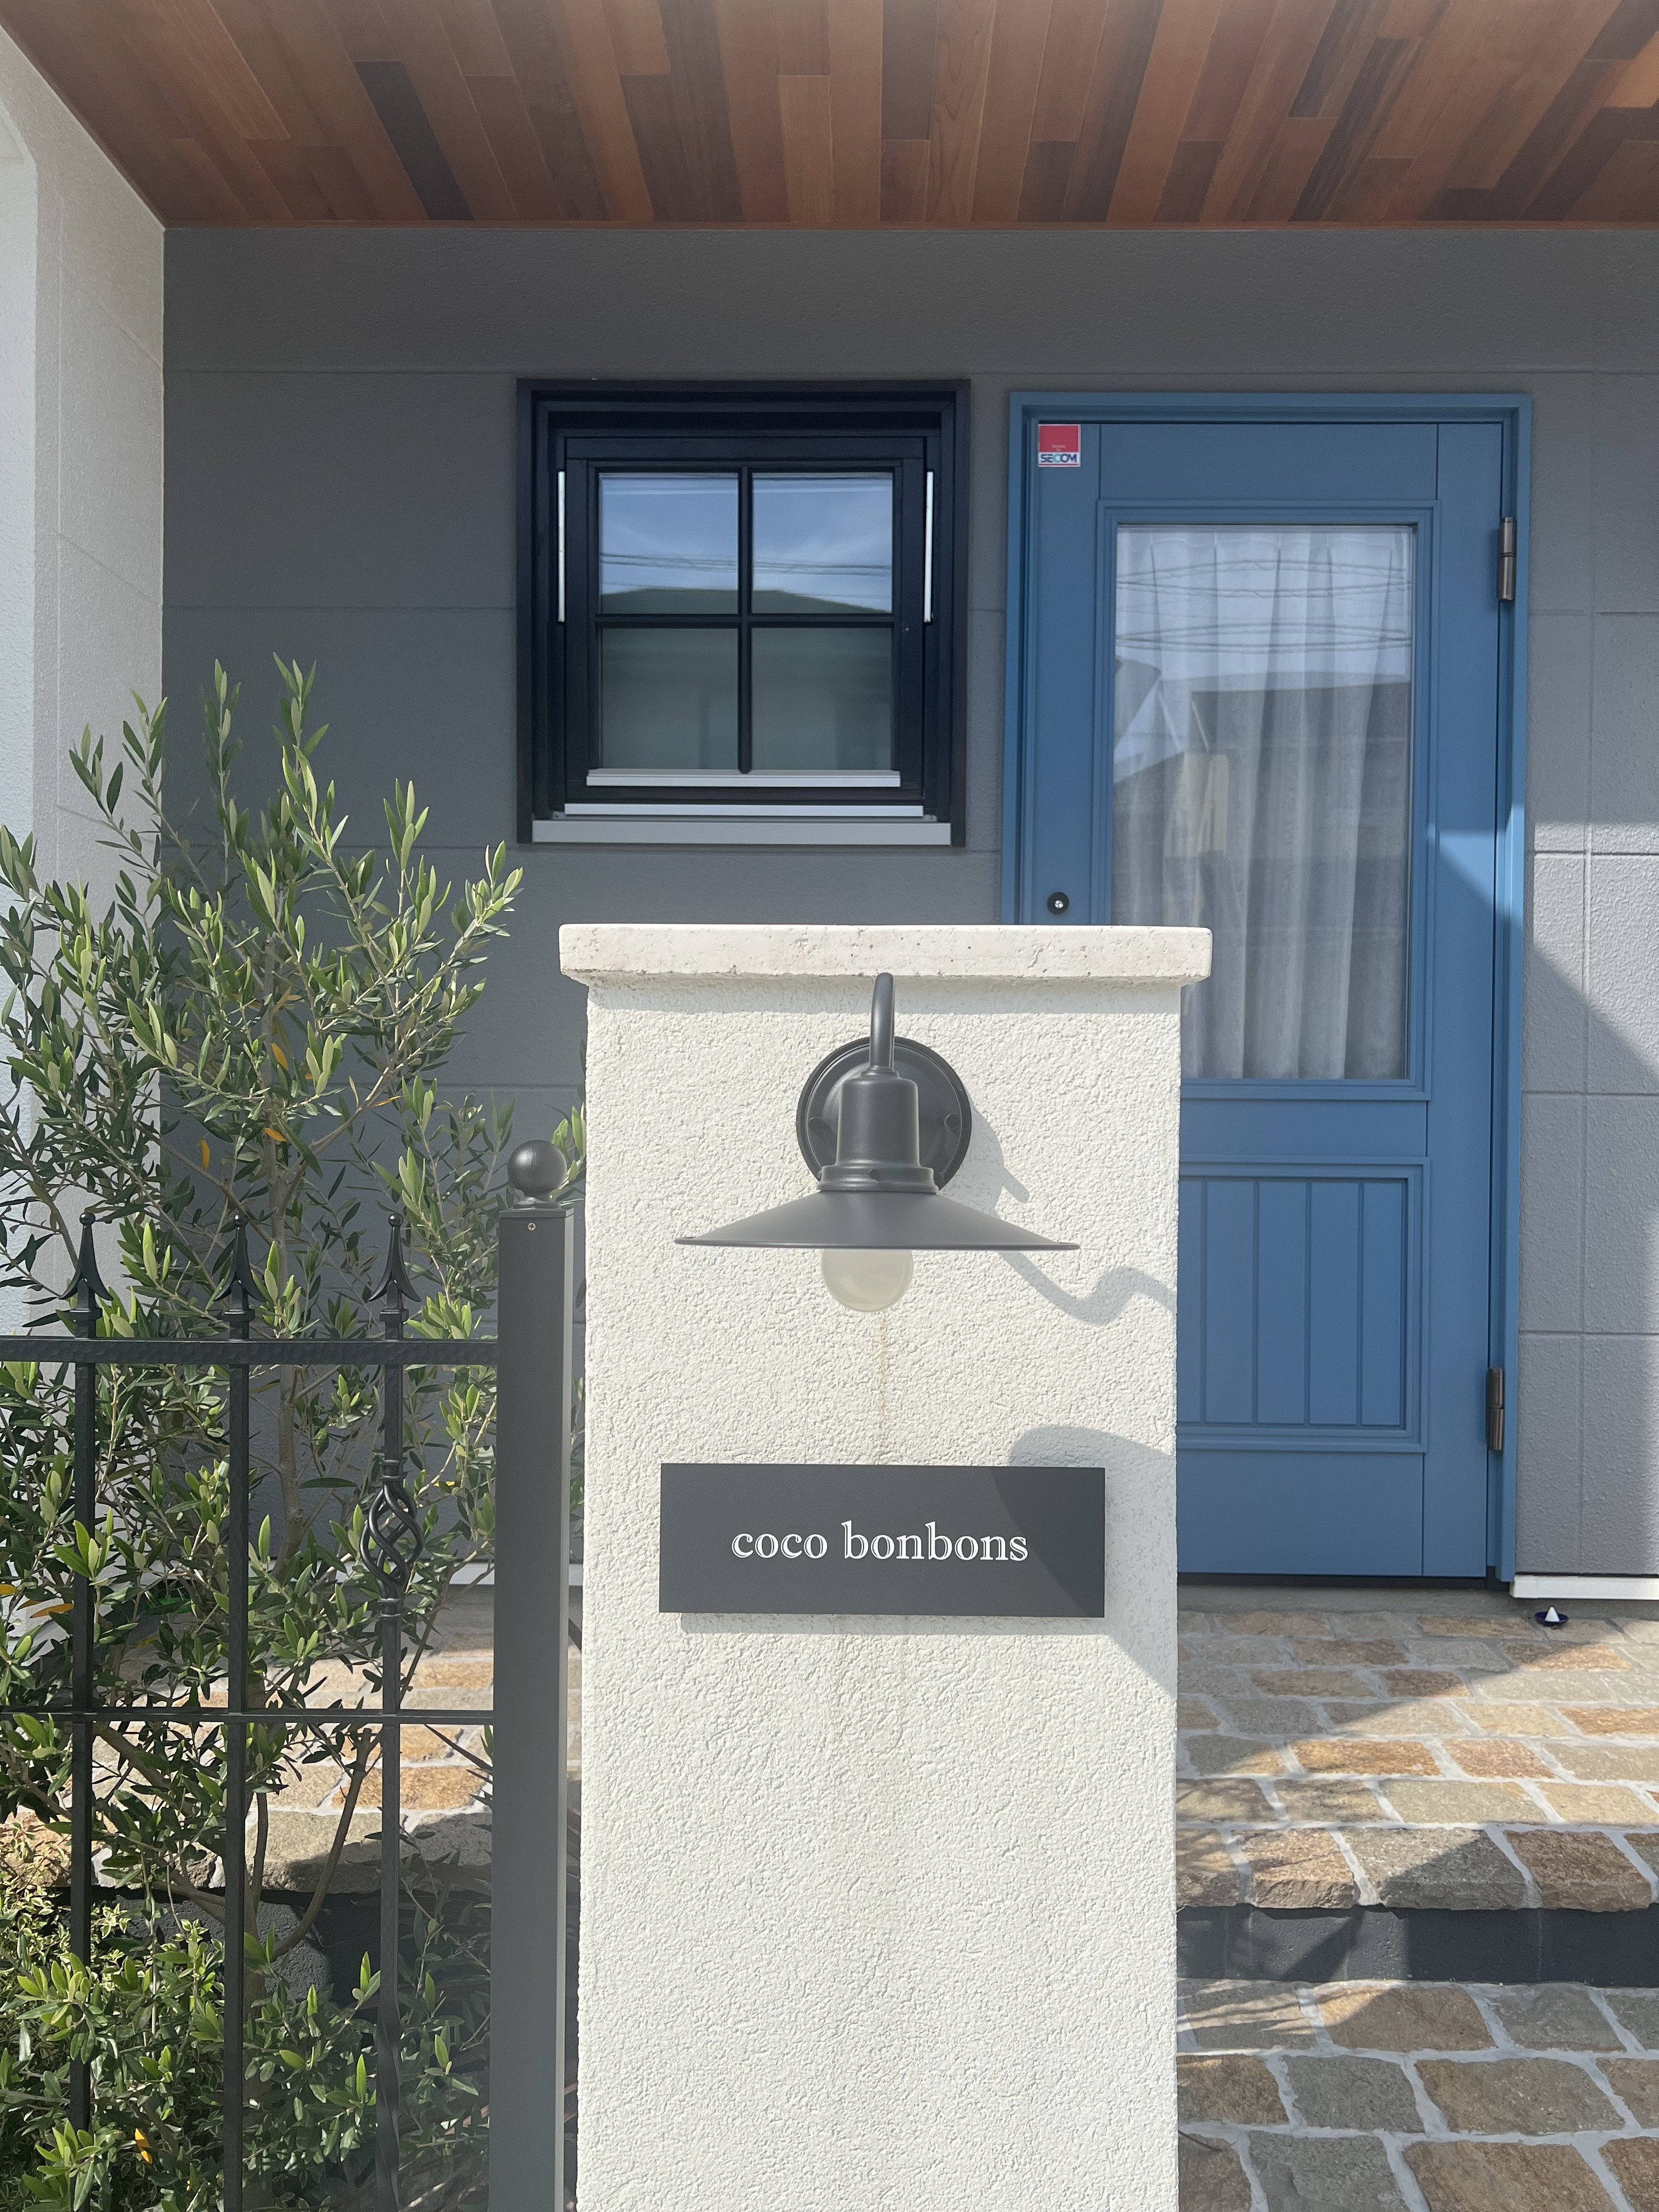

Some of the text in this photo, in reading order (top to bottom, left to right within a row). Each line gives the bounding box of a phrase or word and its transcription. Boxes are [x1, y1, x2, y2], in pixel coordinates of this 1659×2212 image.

[1041, 453, 1077, 463] SECOM
[731, 1520, 1029, 1561] coco bonbons
